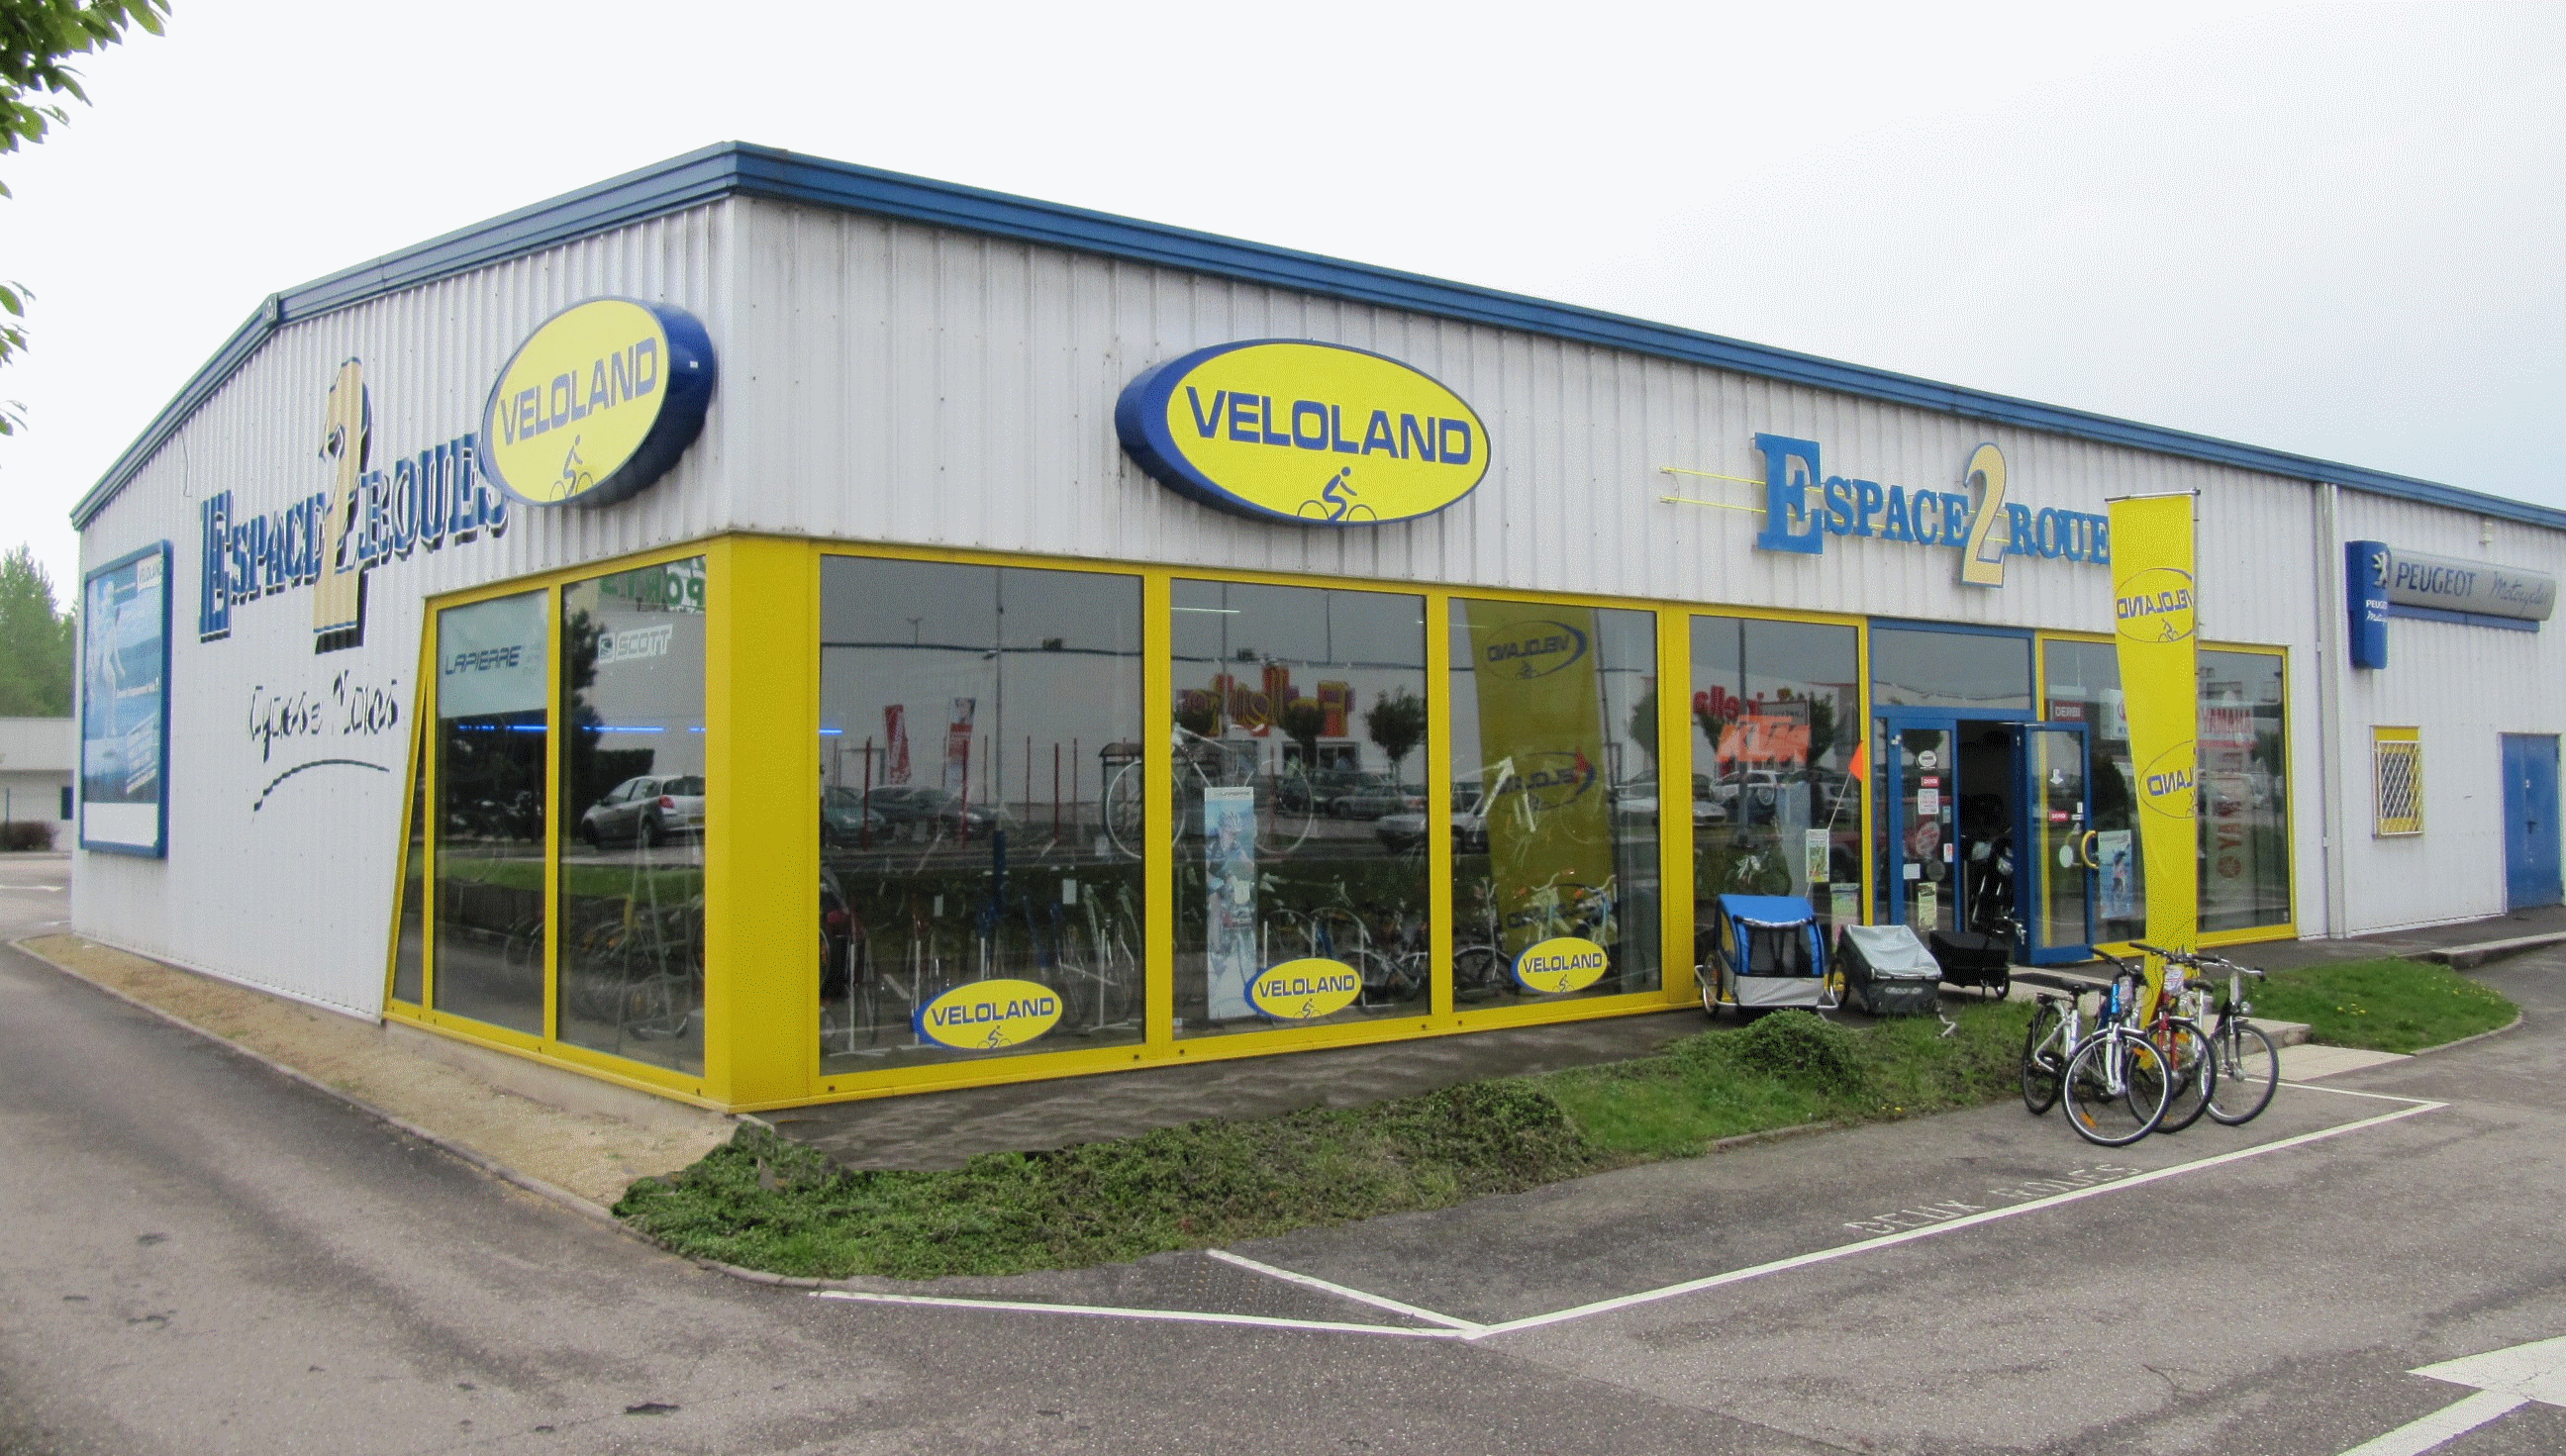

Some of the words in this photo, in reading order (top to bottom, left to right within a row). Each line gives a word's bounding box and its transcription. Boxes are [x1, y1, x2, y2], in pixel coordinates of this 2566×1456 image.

[500, 337, 658, 445] VELOLAND
[1185, 386, 1472, 465] VELOLAND
[313, 356, 372, 654] 2
[1755, 433, 1968, 554] ESPACE
[1961, 442, 2007, 588] 2
[2005, 502, 2110, 564] ROUE
[2396, 562, 2476, 596] PEUGEOT
[616, 625, 673, 660] SCOTT
[445, 645, 525, 685] LAPIERRE
[1524, 953, 1603, 972] VELOLAND
[1258, 975, 1355, 997] VELOLAND
[931, 997, 1055, 1026] VELOLAND
